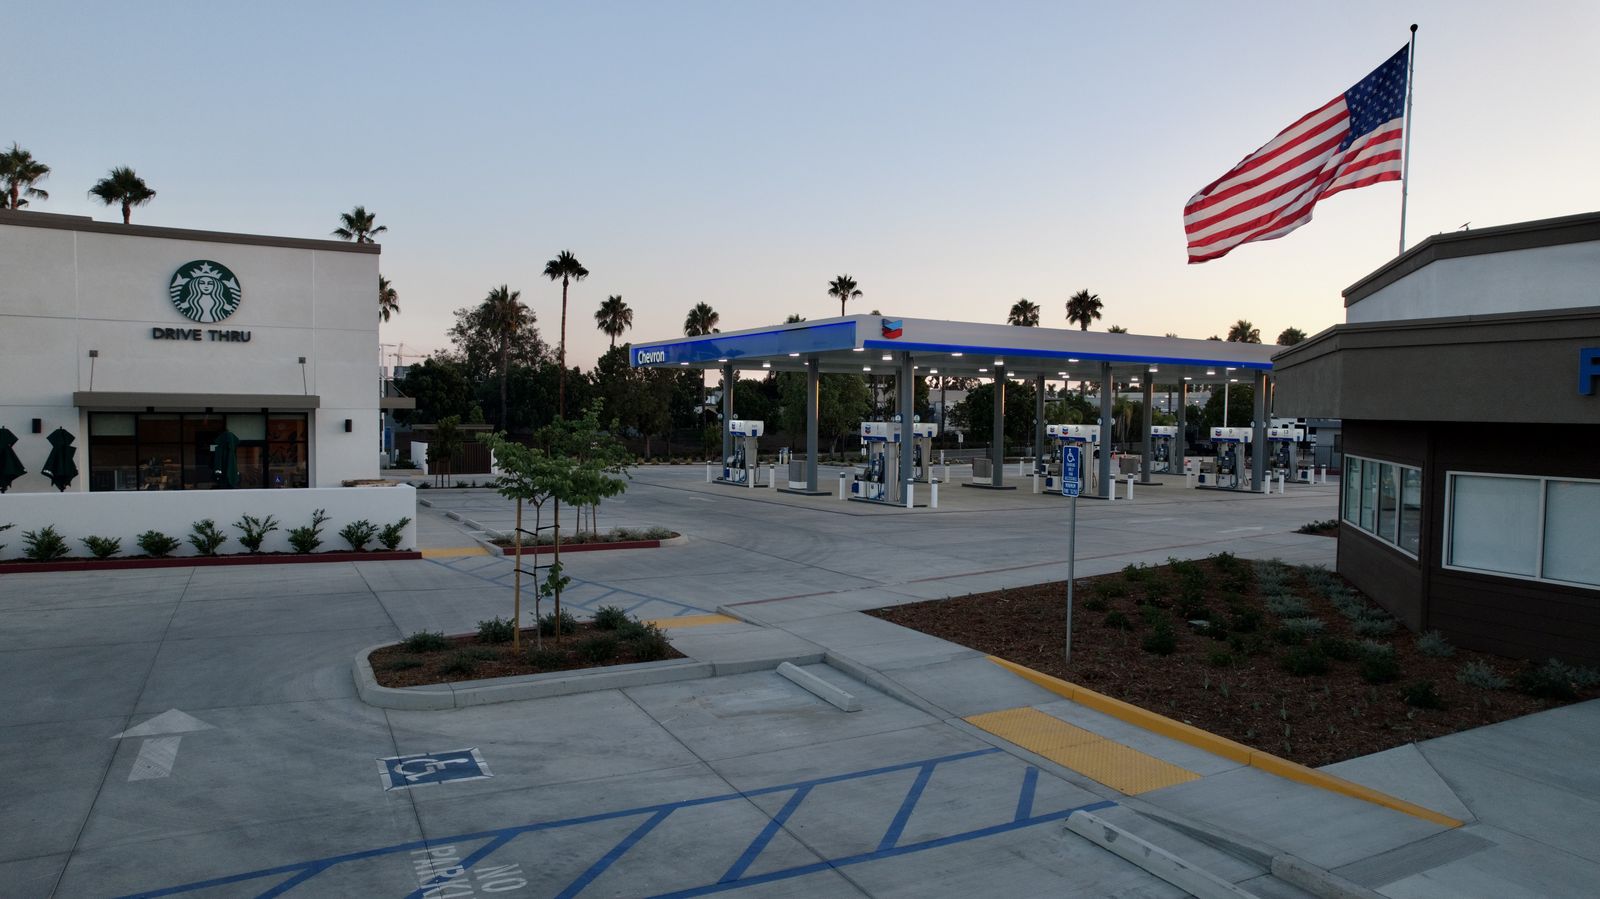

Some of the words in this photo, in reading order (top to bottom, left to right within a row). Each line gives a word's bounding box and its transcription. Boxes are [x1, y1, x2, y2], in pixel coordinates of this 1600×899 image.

[152, 327, 203, 341] DRIVE
[208, 329, 251, 343] THRU
[637, 350, 665, 365] Chevron
[410, 845, 476, 899] PARKI
[473, 863, 528, 893] NO
